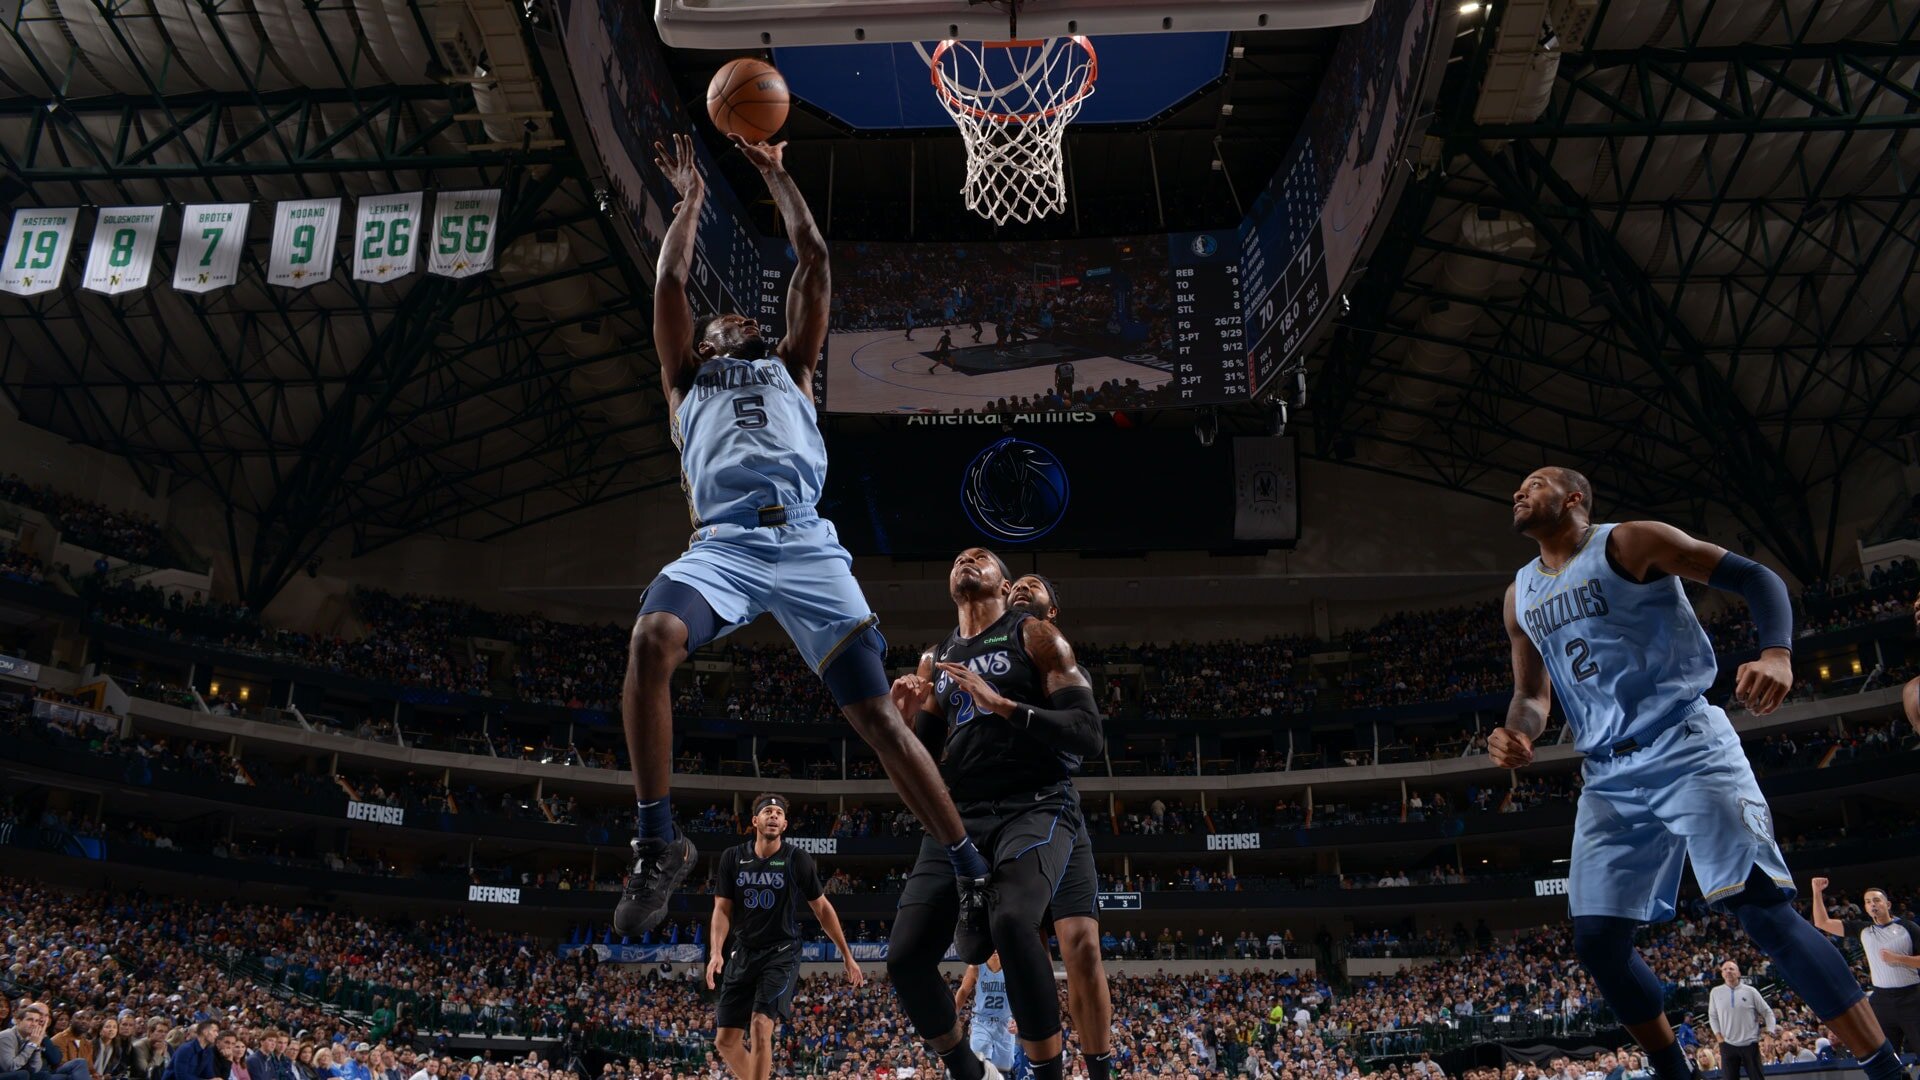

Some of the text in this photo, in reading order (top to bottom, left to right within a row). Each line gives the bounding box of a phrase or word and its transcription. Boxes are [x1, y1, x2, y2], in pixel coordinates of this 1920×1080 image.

[369, 204, 409, 215] LEHTINEN
[454, 200, 481, 210] ZUBOV
[103, 214, 155, 225] GOLDSWORTHY
[199, 212, 233, 223] BROTEN
[290, 208, 325, 219] MODANO
[22, 216, 68, 226] MASTERTON
[362, 218, 411, 260] 26
[438, 214, 490, 255] 56
[14, 230, 59, 269] 19
[108, 228, 137, 267] 8
[199, 227, 224, 267] 7
[290, 224, 316, 265] 9
[1298, 242, 1311, 277] 77
[696, 252, 708, 286] 70
[763, 269, 781, 278] REB
[1176, 266, 1238, 277] REB 34
[762, 281, 775, 290] TO
[1176, 281, 1189, 289] TO
[761, 294, 780, 303] BLK
[1177, 291, 1240, 303] BLK 3
[760, 306, 776, 315] STL
[1177, 302, 1240, 314] STL 8
[1259, 299, 1274, 330] 70
[1178, 316, 1242, 329] FG 26/72
[1280, 301, 1300, 336] 18.0
[760, 324, 772, 333] FG
[1179, 329, 1243, 342] 3-PT 9/29
[1180, 342, 1244, 355] FT 9/12
[1180, 364, 1193, 372] FG
[1181, 376, 1202, 385] 3-PT
[1182, 390, 1193, 398] FT
[732, 395, 769, 429] 5
[1524, 578, 1609, 645] GRIZZLIES
[984, 635, 1008, 644] chime
[1565, 637, 1600, 683] 2
[347, 800, 404, 826] DEFENSE!
[1206, 832, 1260, 851] DEFENSE!
[736, 871, 784, 889] MAVS
[468, 884, 520, 904] DEFENSE!
[743, 888, 775, 910] 30
[1122, 900, 1128, 908] 3
[984, 996, 1005, 1009] 22
